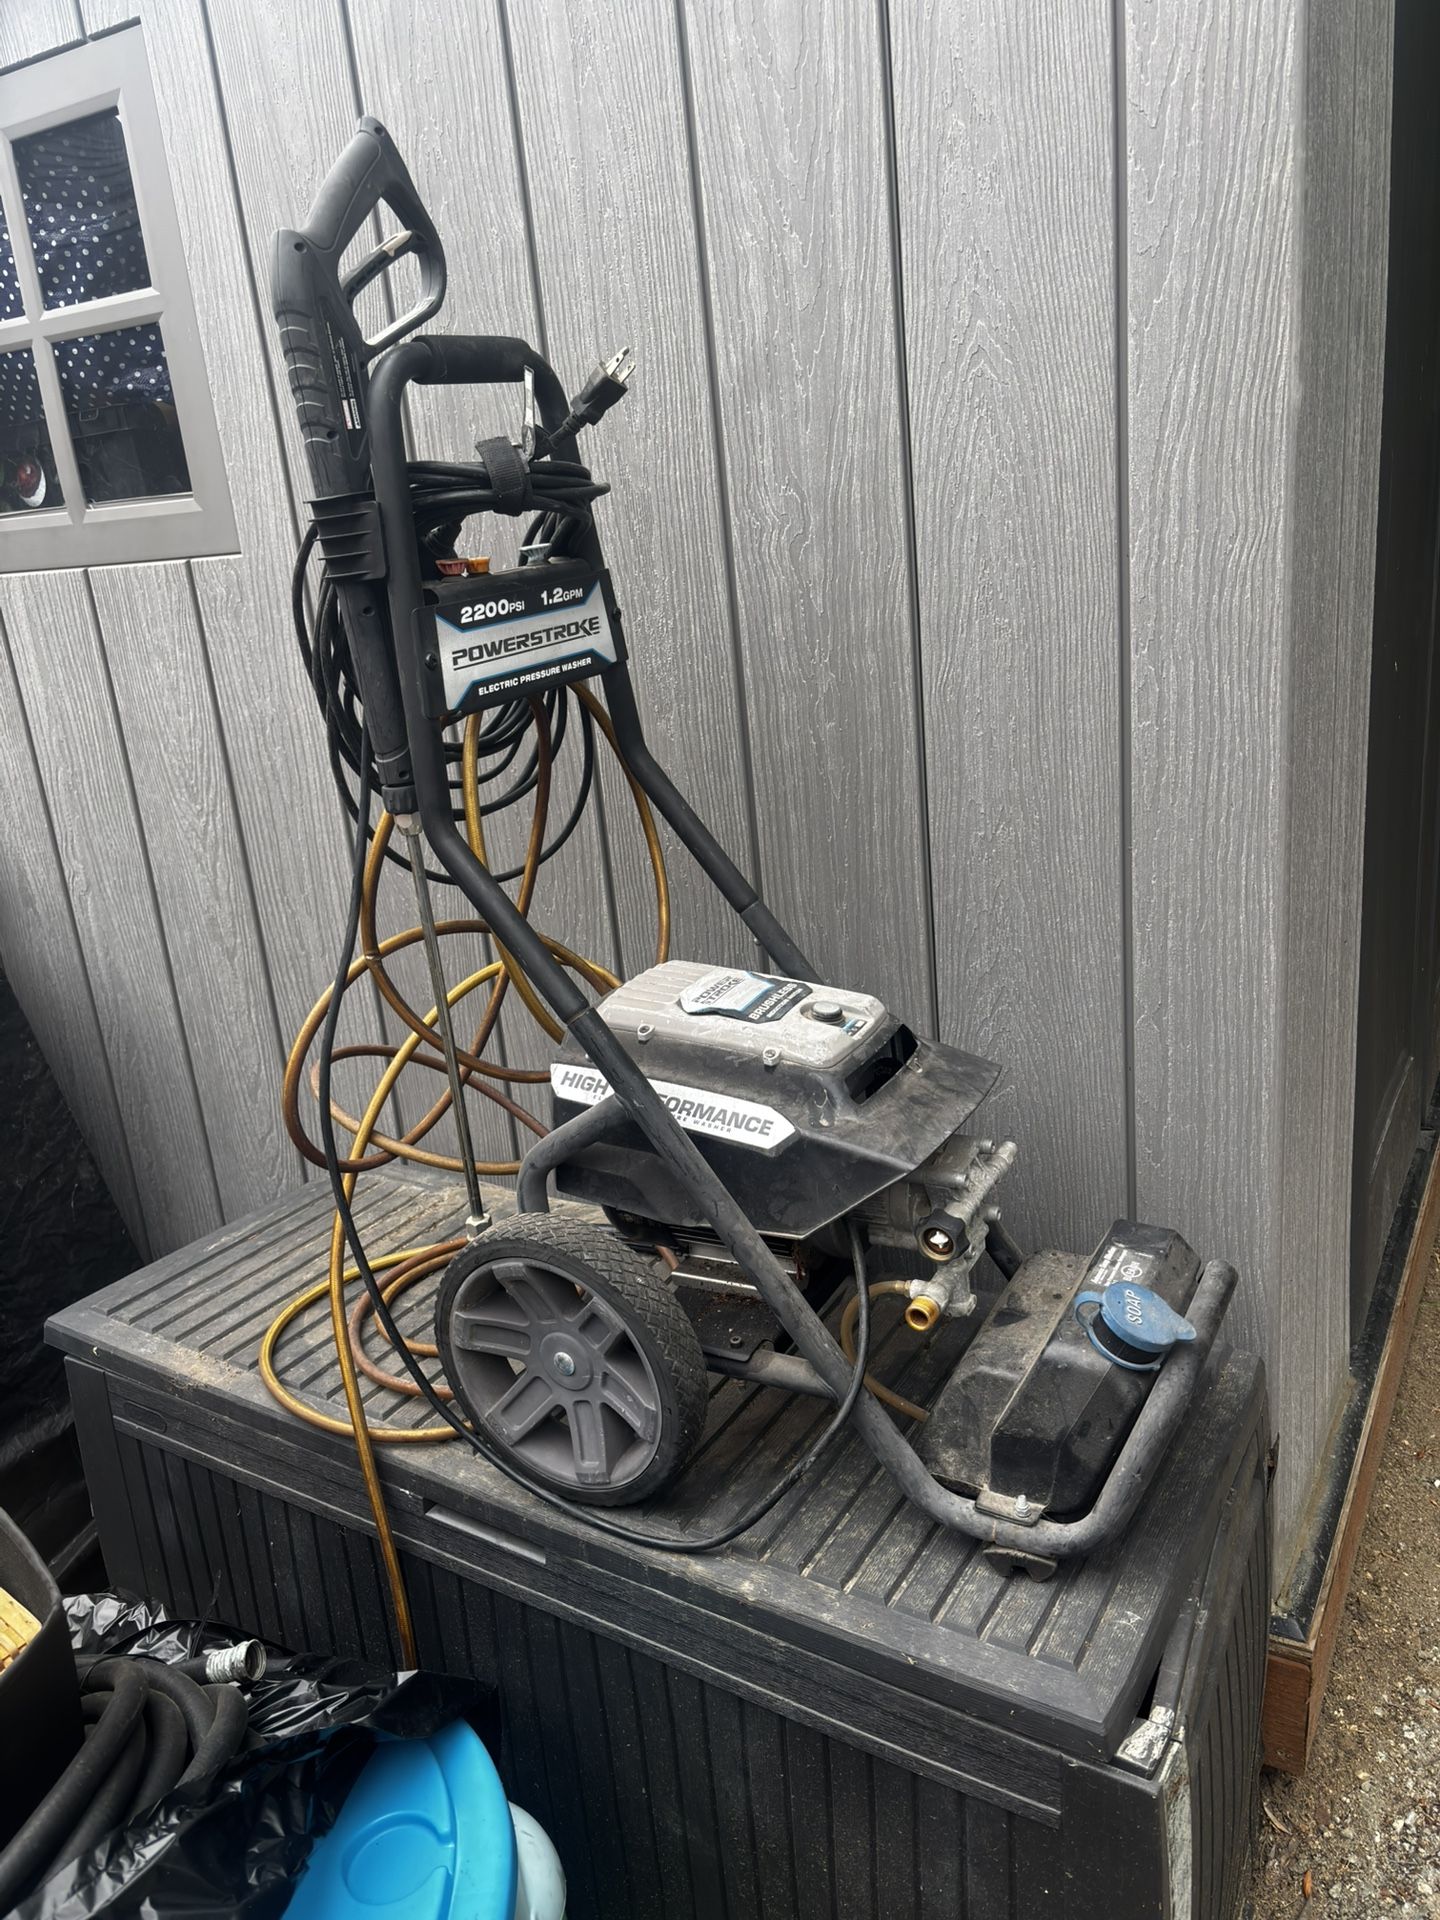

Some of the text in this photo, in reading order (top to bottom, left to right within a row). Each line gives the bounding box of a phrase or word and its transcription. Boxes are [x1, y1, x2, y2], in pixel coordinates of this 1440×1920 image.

[452, 616, 601, 667] POWERSTROKE
[478, 657, 592, 696] ELECTRIC PRESSURE WASHER
[748, 982, 798, 1020] BRUSHLESS
[560, 1071, 610, 1096] HIGH
[693, 1119, 732, 1133] WASHER
[1125, 1289, 1144, 1325] SOAP
